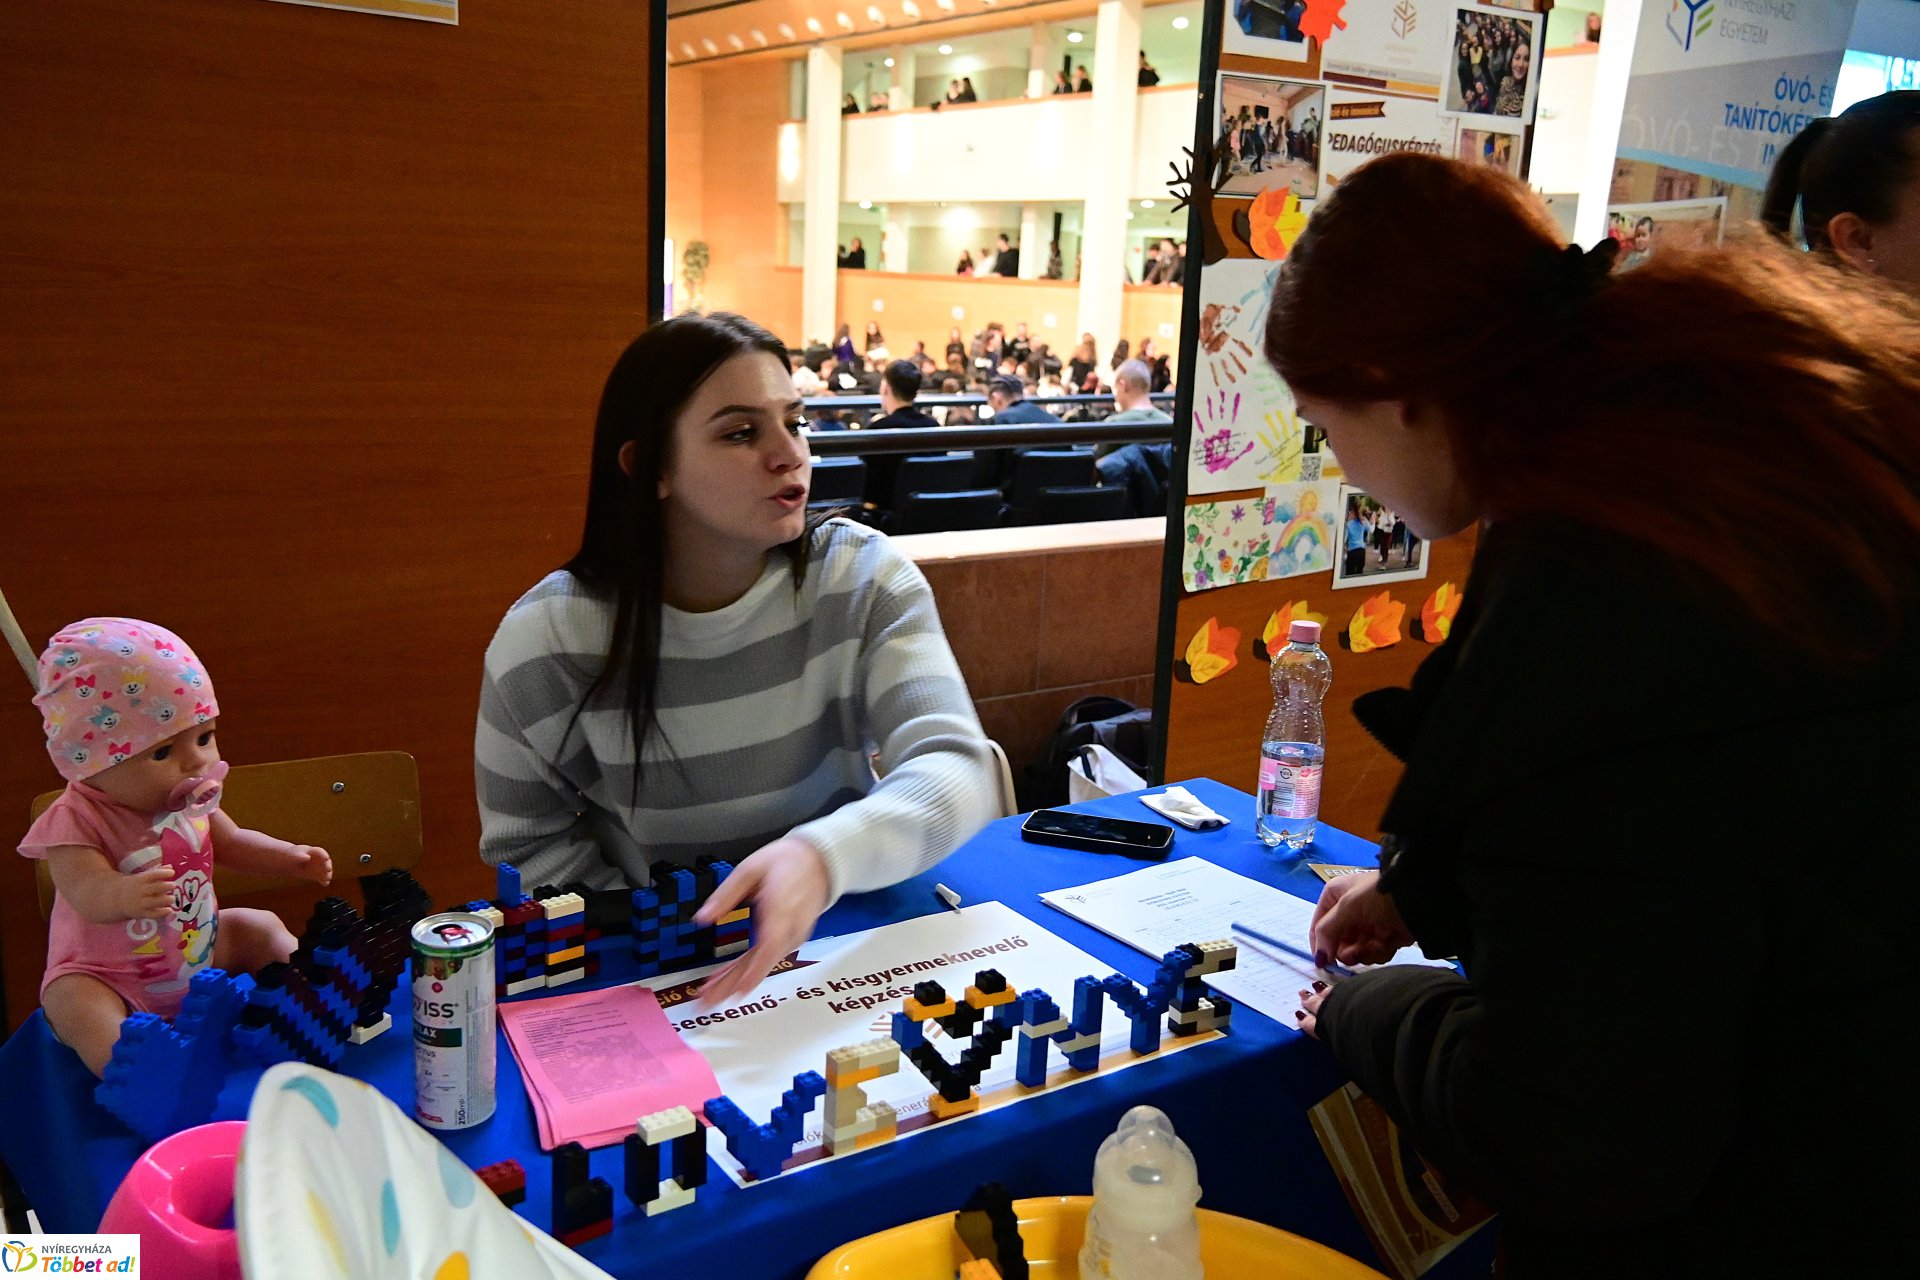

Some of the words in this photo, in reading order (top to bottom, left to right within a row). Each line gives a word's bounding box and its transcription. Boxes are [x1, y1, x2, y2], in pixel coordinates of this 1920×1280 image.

[1774, 71, 1816, 105] ÓVÓ-
[1724, 102, 1813, 135] TANÍTÓKÉP
[796, 986, 826, 1000] és
[827, 935, 1029, 993] kisgyermeknevelő
[827, 985, 914, 1014] képzés
